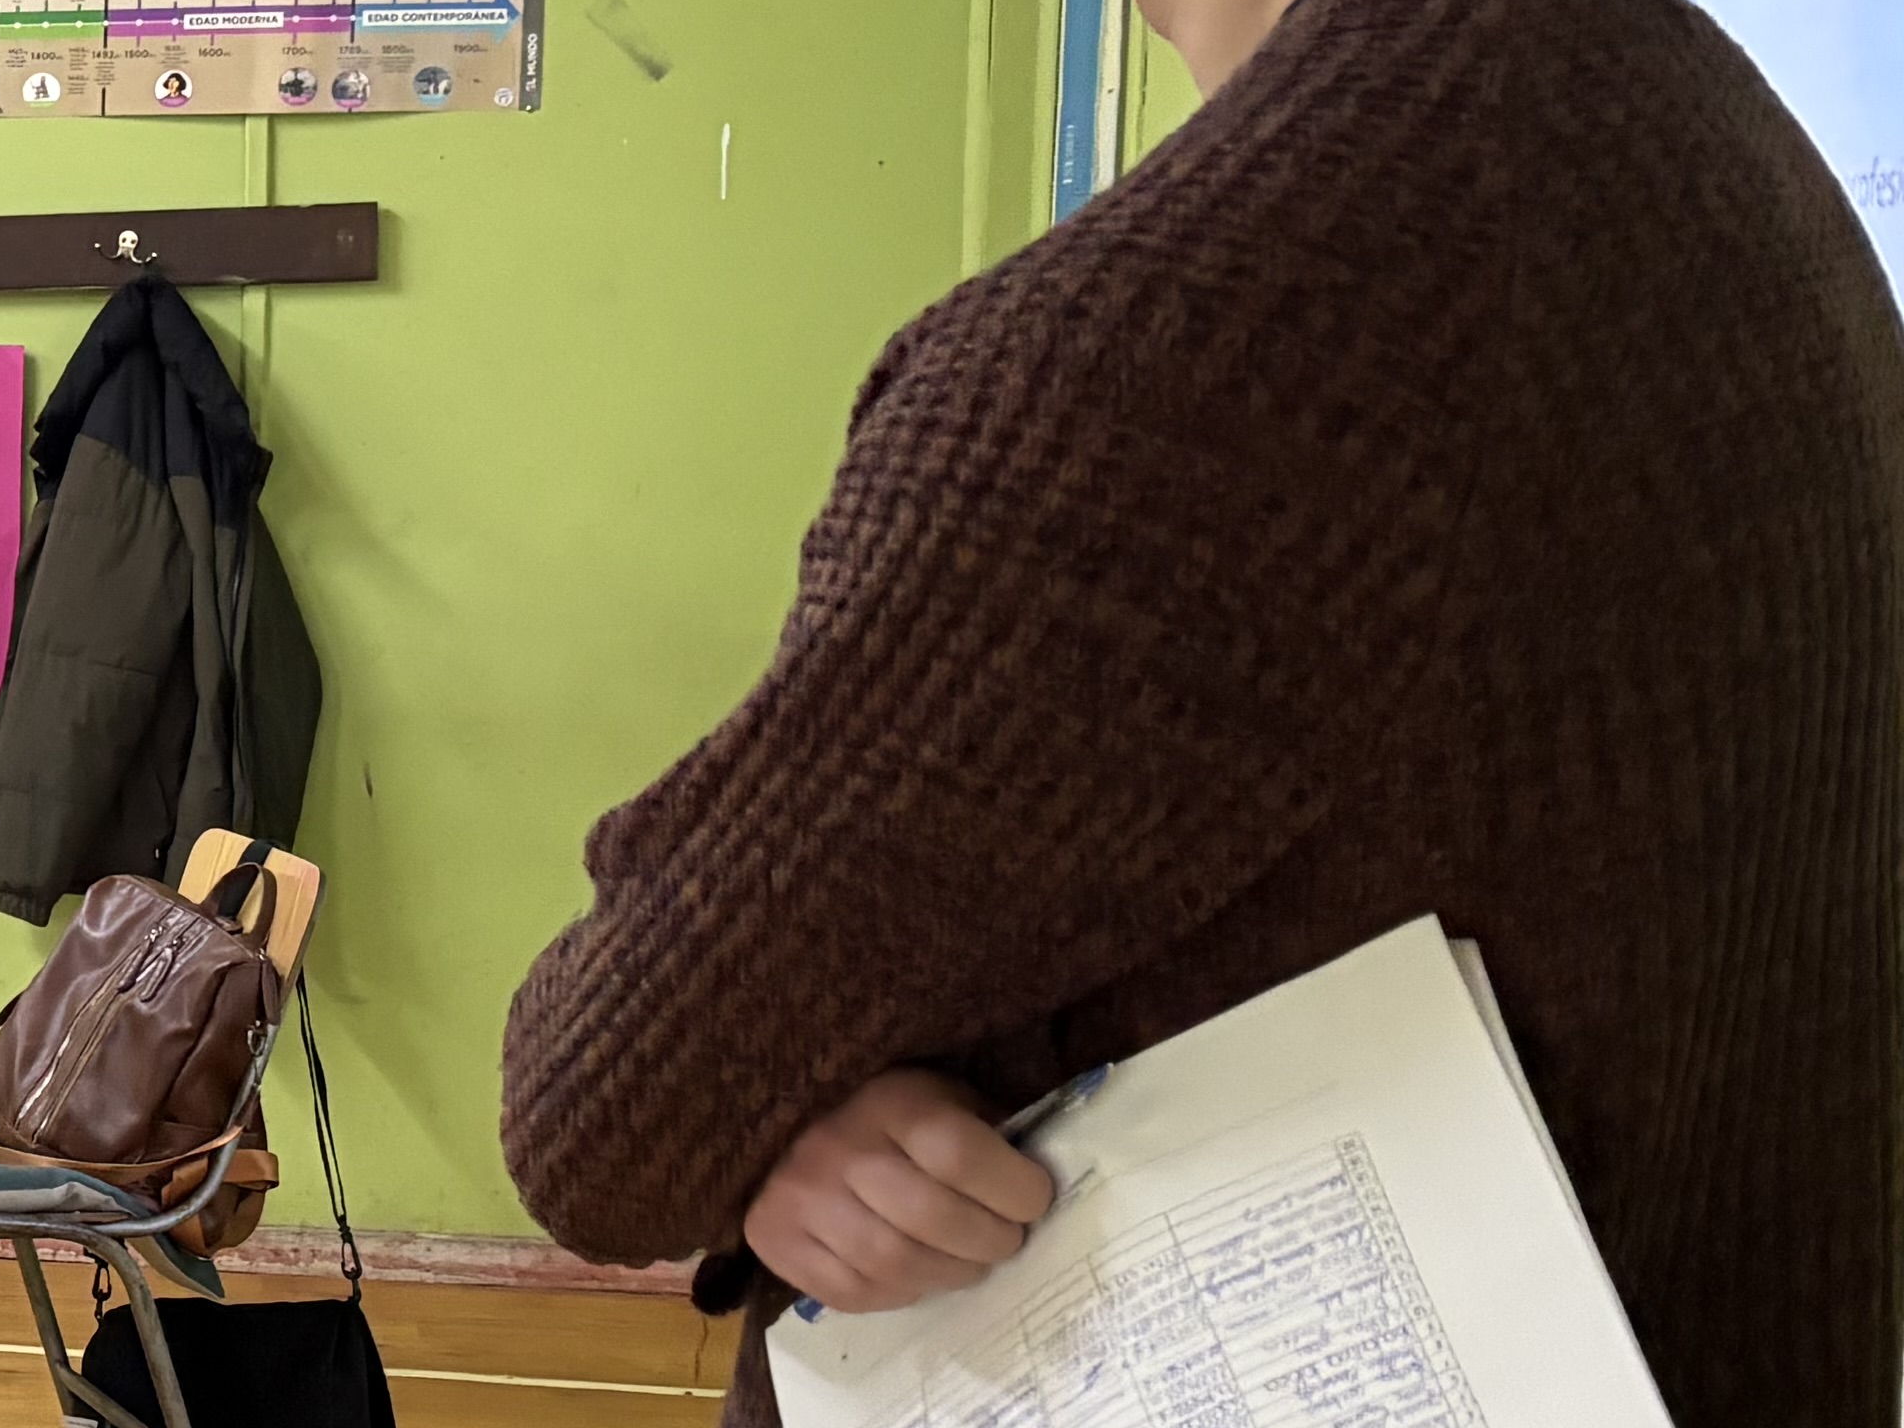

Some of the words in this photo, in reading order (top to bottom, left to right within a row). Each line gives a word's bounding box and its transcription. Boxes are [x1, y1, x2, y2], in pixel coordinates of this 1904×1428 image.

[189, 17, 219, 26] EDAD
[222, 16, 278, 25] MODERNA
[367, 13, 399, 22] EDAD
[401, 10, 505, 22] CONTEMPORÁNEA
